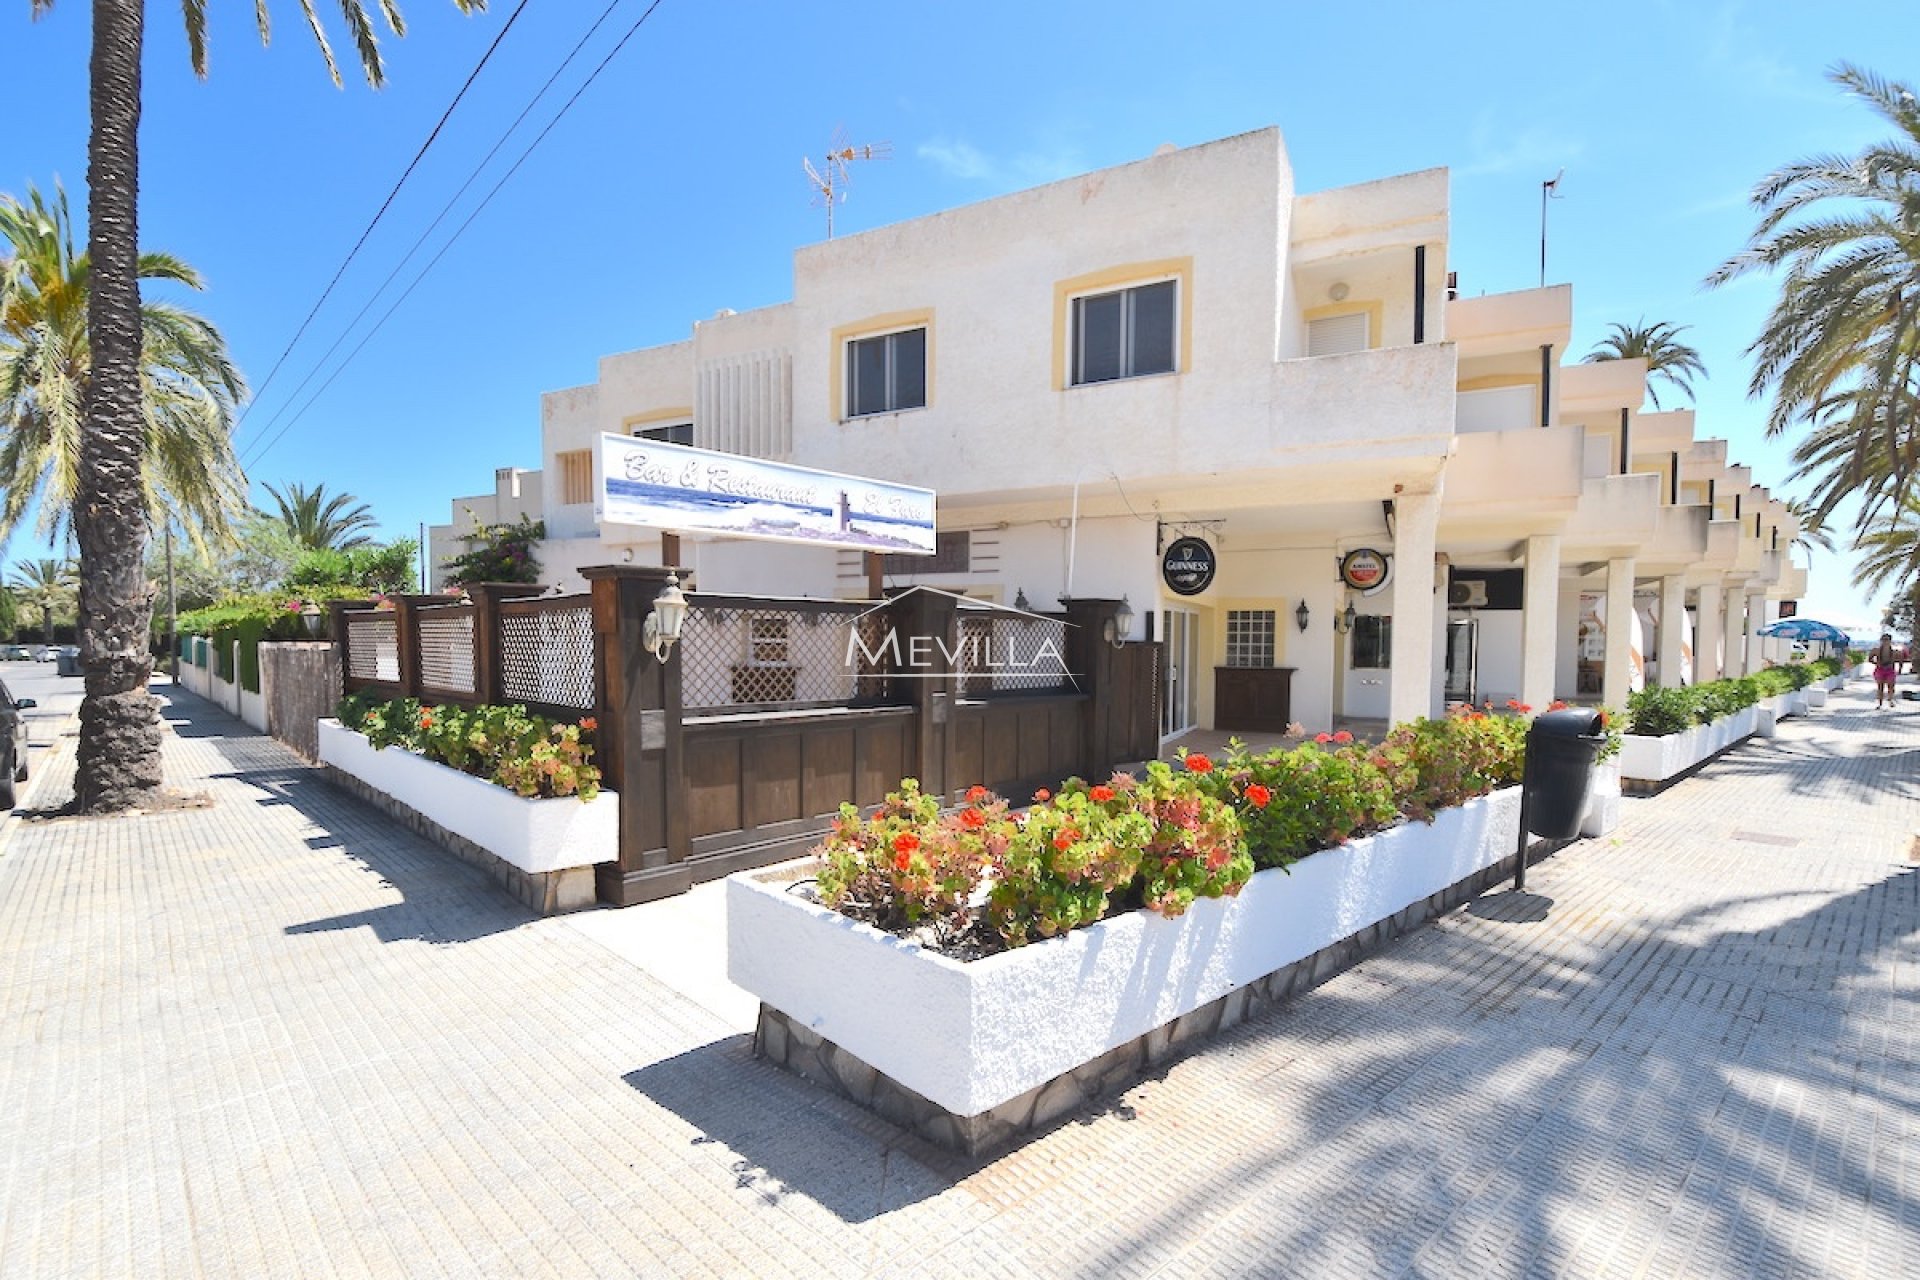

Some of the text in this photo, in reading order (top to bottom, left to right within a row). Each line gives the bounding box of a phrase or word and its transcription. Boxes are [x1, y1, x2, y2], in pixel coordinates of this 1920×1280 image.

[623, 448, 819, 506] Bar & Restaurant
[1166, 559, 1209, 572] GUINNESS
